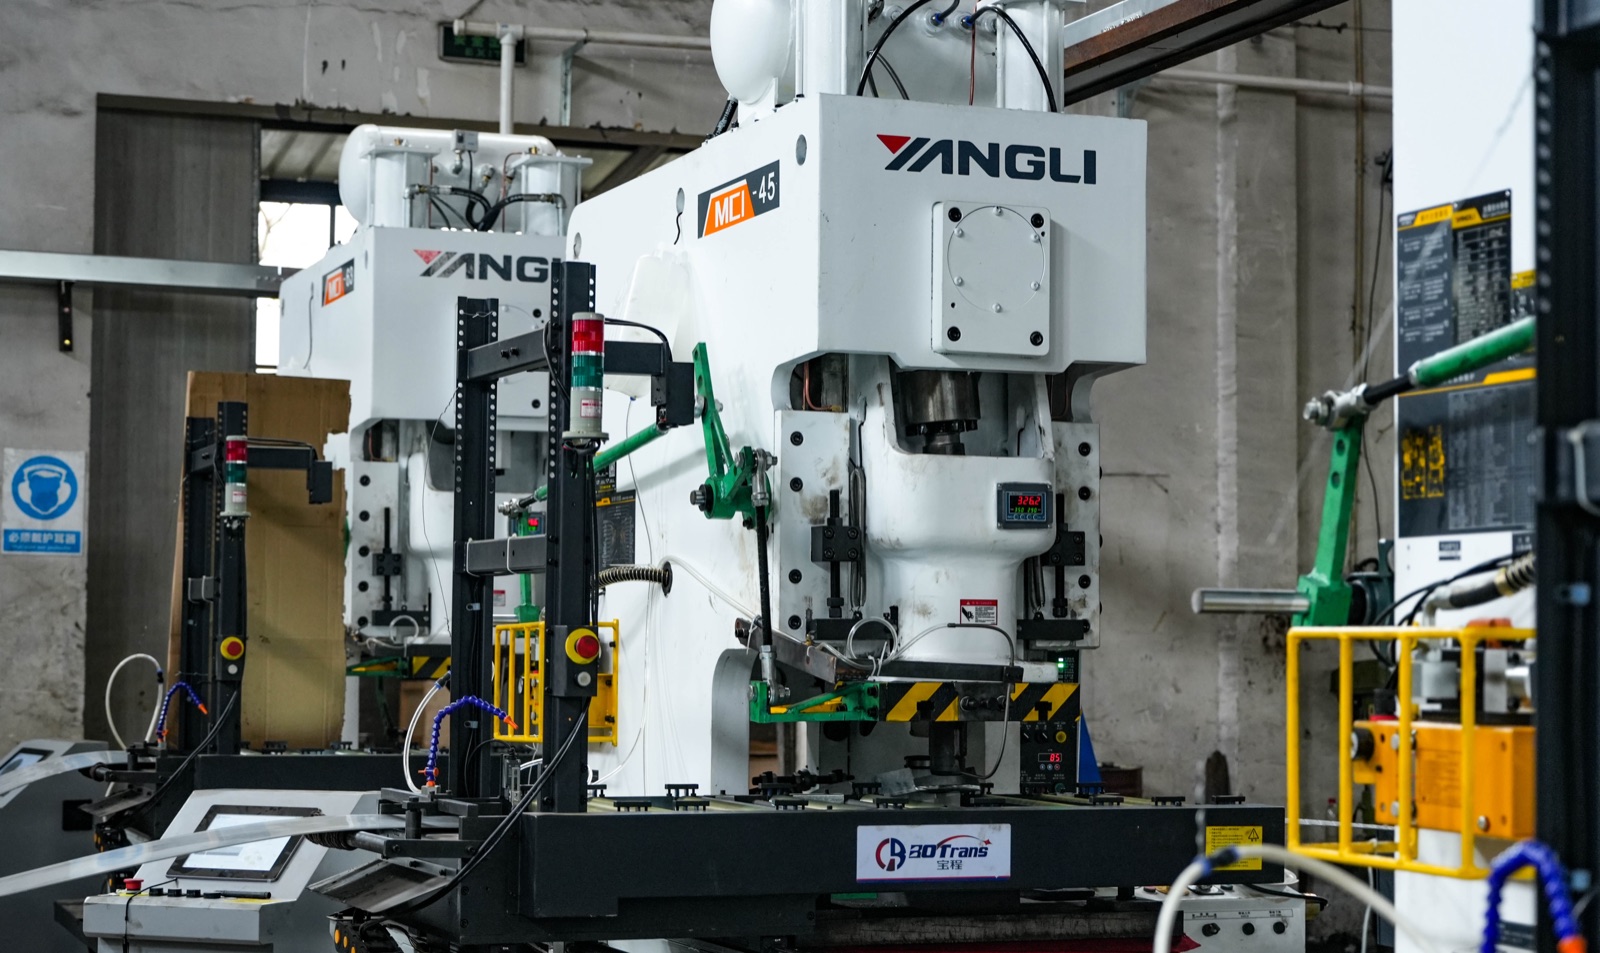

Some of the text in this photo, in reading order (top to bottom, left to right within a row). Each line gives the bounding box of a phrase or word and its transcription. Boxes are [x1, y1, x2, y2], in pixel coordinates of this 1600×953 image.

[877, 134, 1096, 185] YANGLI
[413, 249, 561, 283] YANG
[1049, 753, 1060, 762] 85
[936, 859, 963, 871] 宝程
